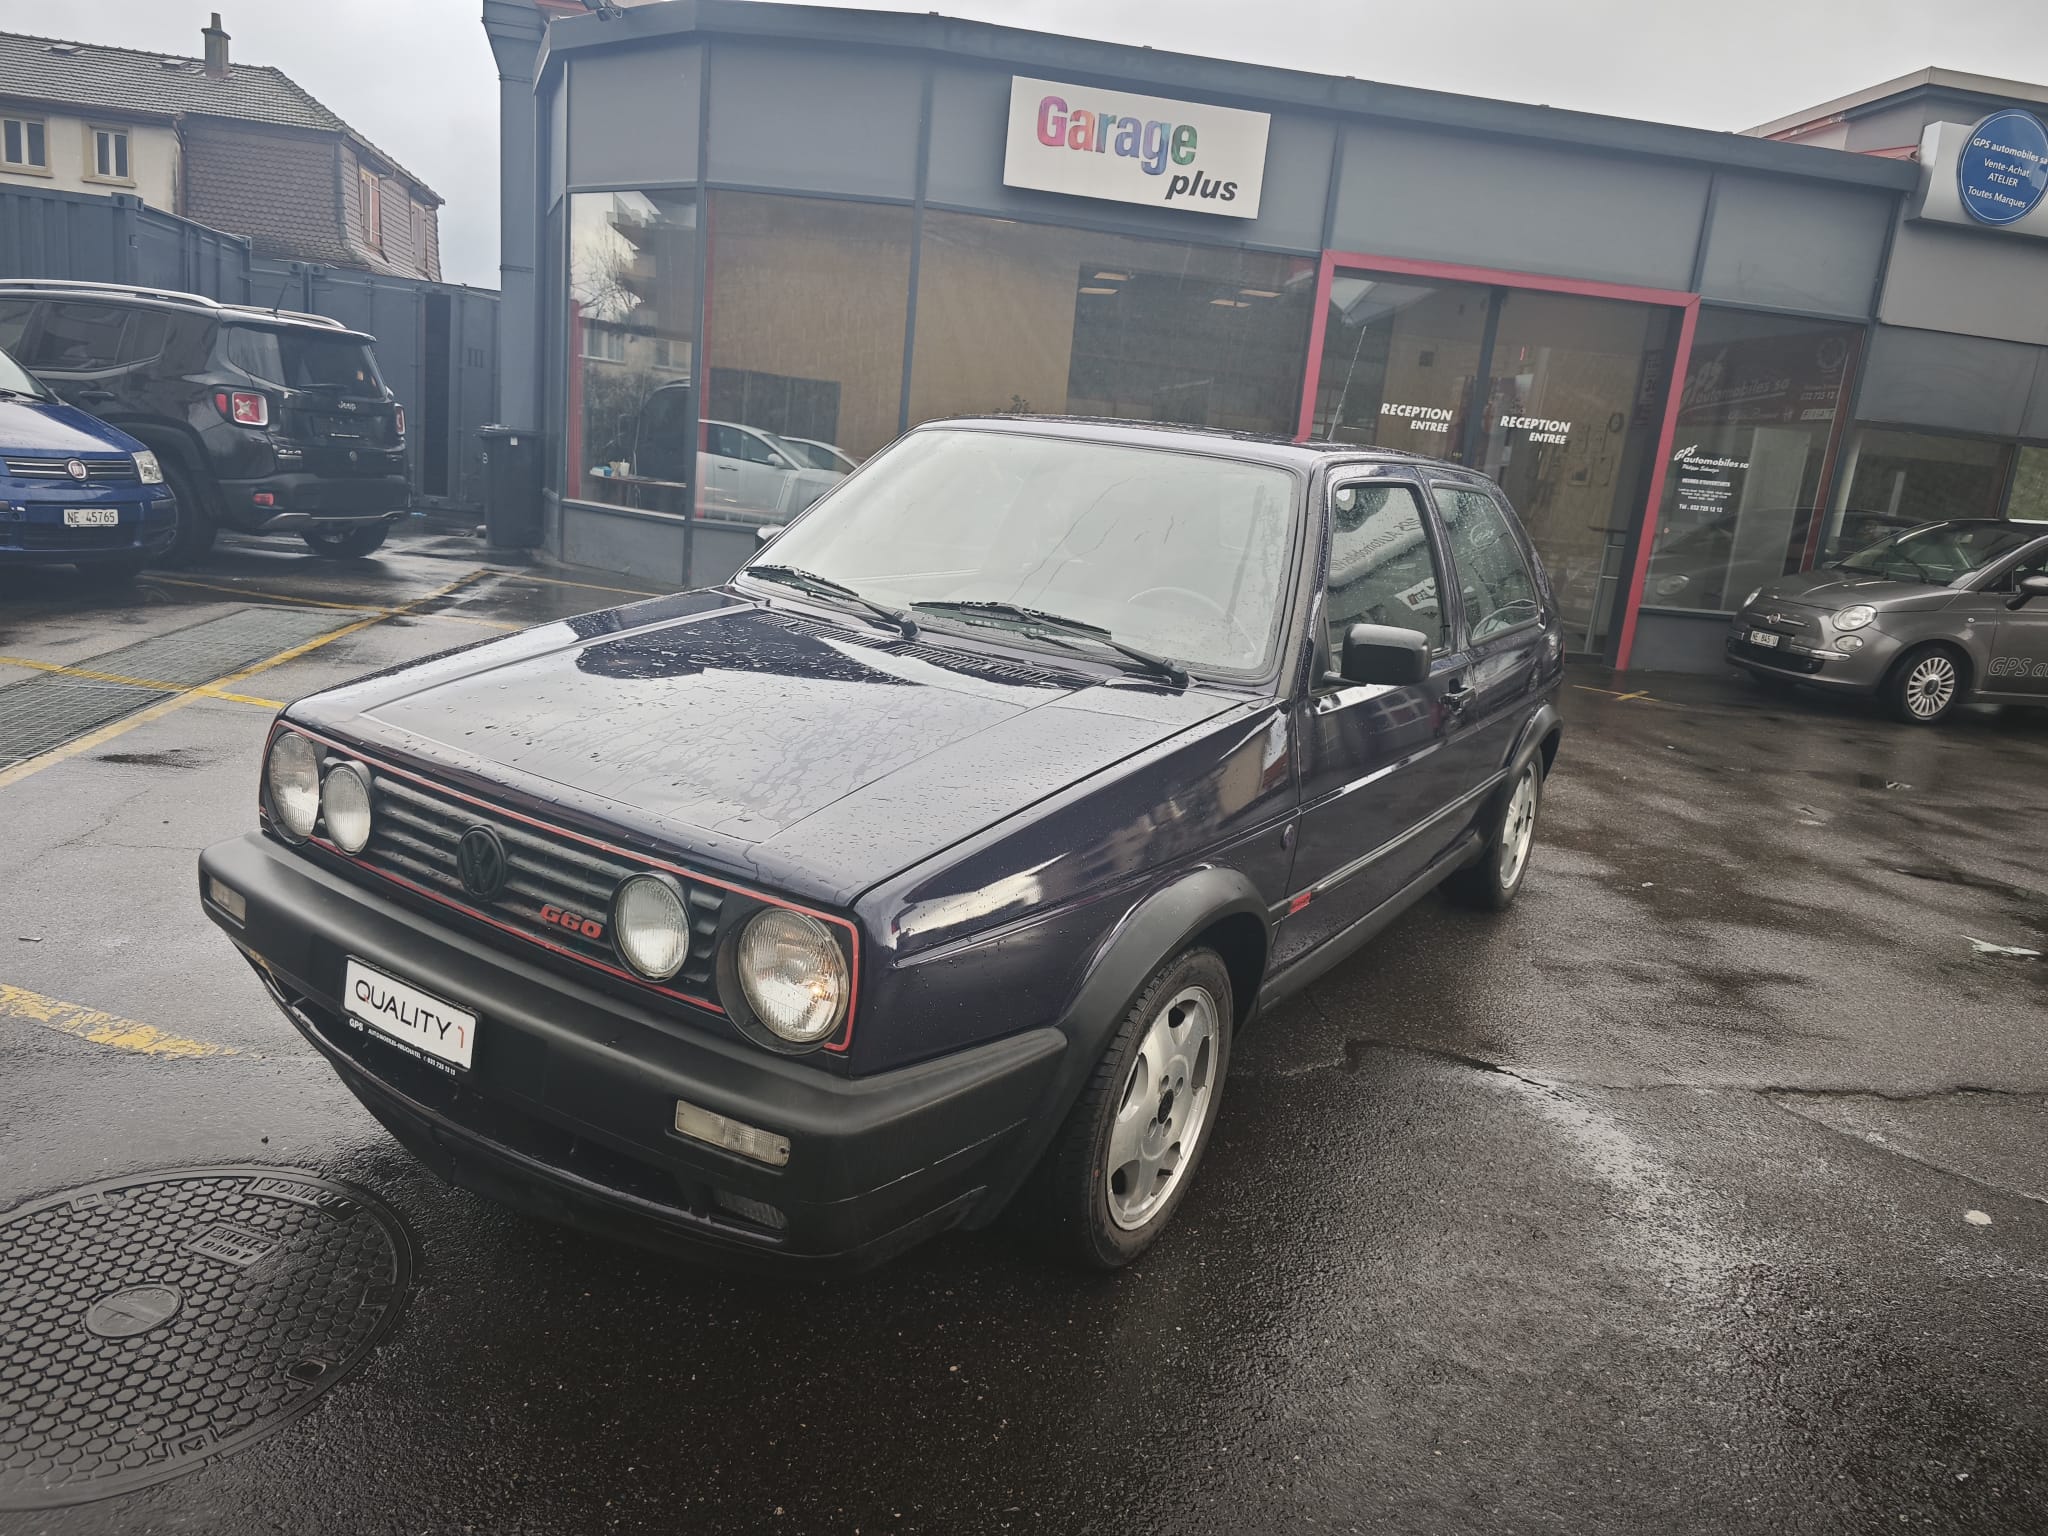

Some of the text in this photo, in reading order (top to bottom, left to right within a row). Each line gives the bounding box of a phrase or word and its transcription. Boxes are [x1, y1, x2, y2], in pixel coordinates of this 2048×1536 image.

[1037, 95, 1198, 176] Garage
[1973, 137, 1991, 149] GPS
[1991, 143, 2039, 162] automobiles
[1984, 158, 2031, 178] Vente-Achat
[1164, 170, 1239, 202] plus
[1988, 173, 2018, 187] ATELIER
[1968, 185, 2026, 208] Toutes Marques
[338, 401, 357, 411] Jeep
[1380, 403, 1453, 422] RECEPTION
[1410, 420, 1449, 433] ENTREE
[1500, 415, 1571, 433] RECEPTION
[1528, 432, 1567, 445] ENTREE
[1673, 444, 1698, 462] GPS
[1683, 456, 1740, 468] automobiles
[67, 511, 115, 523] NE 45765
[1988, 656, 2032, 677] GPS
[539, 903, 604, 940] G60
[355, 979, 465, 1048] QUALITY 1
[349, 1018, 364, 1032] GPS
